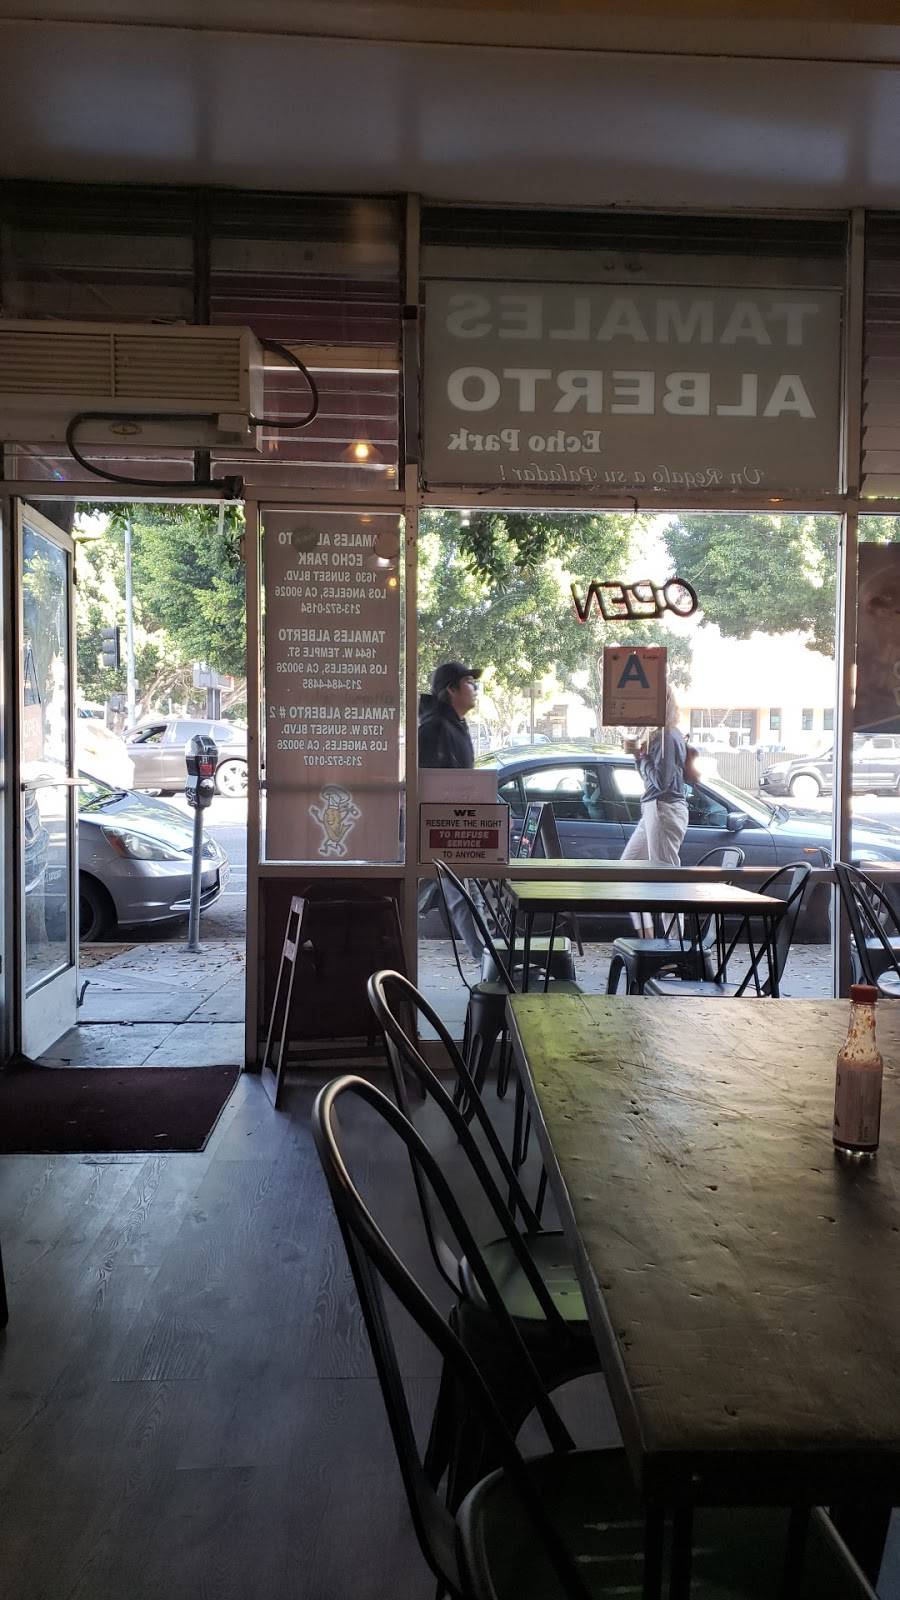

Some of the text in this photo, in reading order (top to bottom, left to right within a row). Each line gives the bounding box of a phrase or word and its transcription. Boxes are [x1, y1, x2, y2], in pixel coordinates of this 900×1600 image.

[617, 655, 650, 688] A
[480, 820, 502, 828] RIGHT
[454, 831, 489, 839] REFUSE
